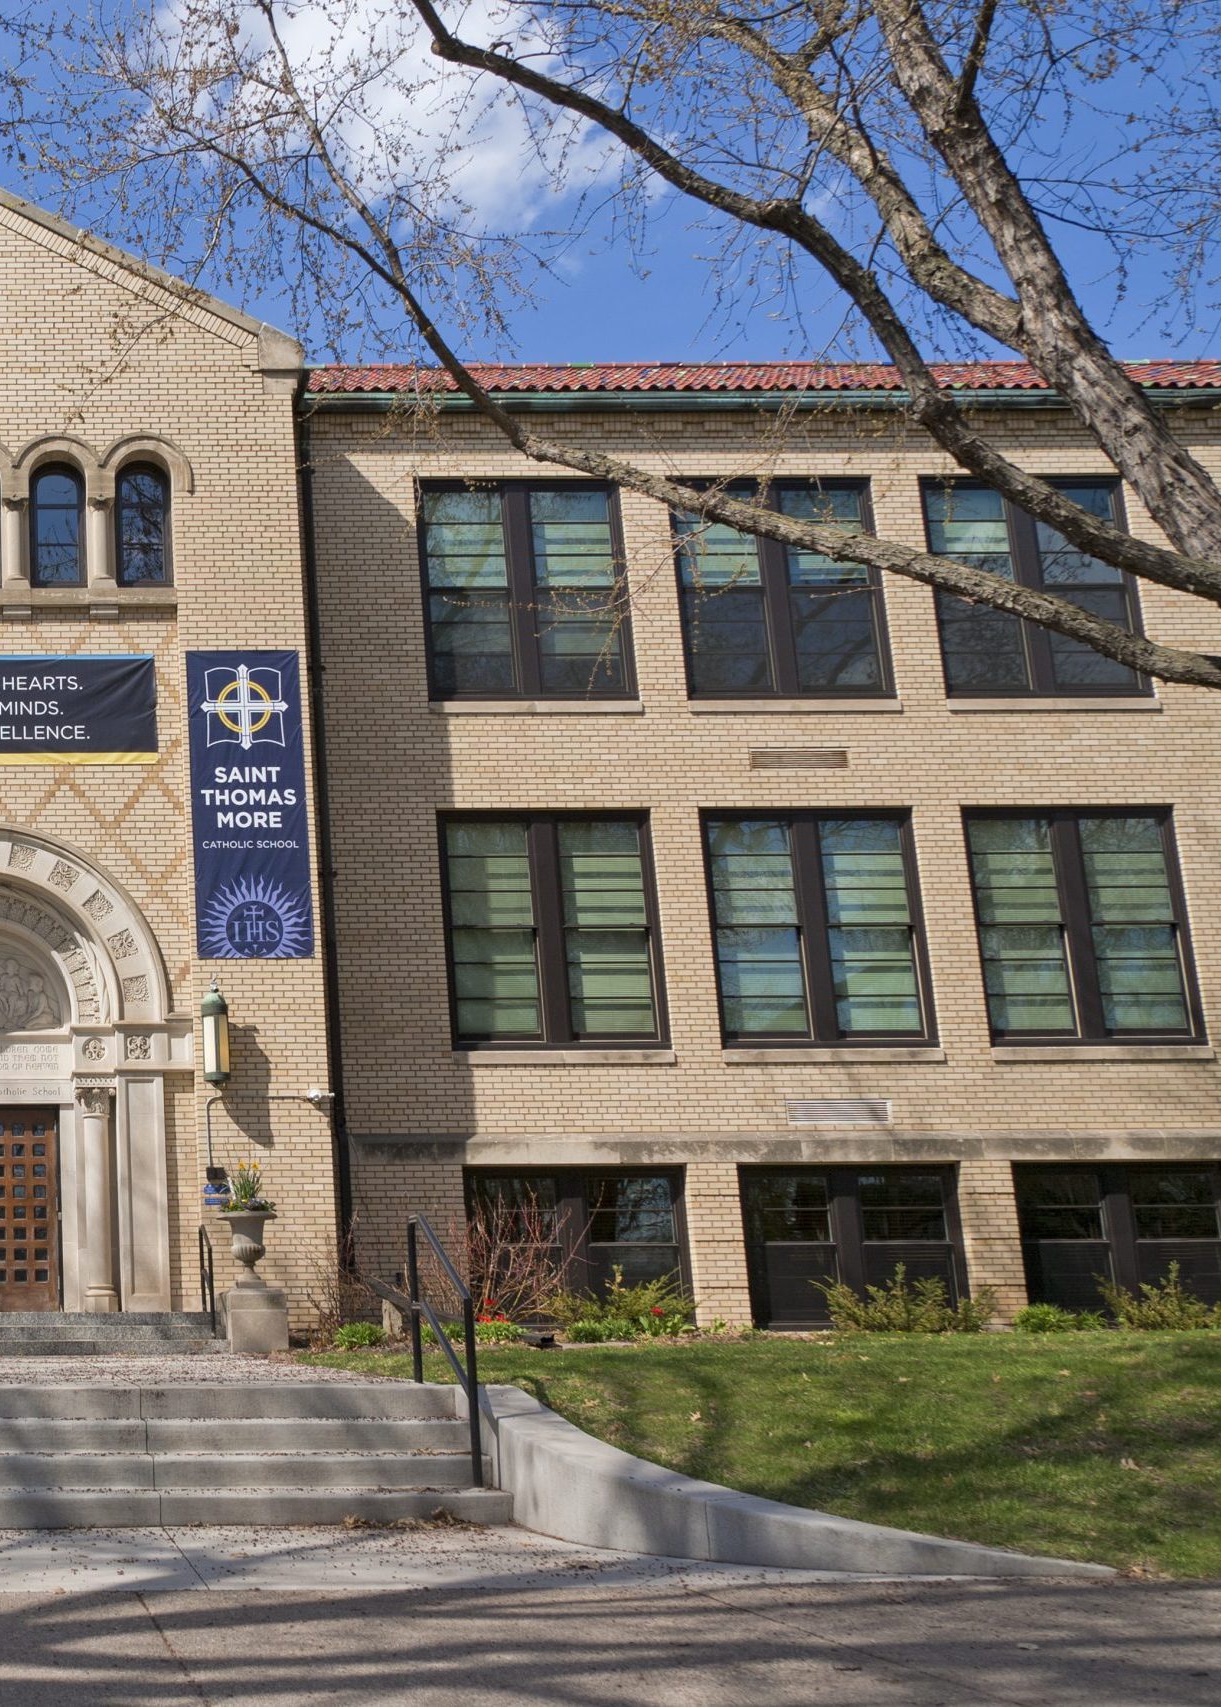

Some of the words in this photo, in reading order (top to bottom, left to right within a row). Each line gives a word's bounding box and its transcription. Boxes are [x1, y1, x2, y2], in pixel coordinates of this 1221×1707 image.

[3, 676, 82, 690] HEARTS.
[0, 701, 63, 715] MINDS.
[215, 767, 280, 783] SAINT
[201, 789, 296, 805] THOMAS
[217, 812, 282, 828] MORE
[257, 840, 299, 848] SCHOOL
[232, 921, 280, 942] IHS
[32, 1086, 61, 1096] School
